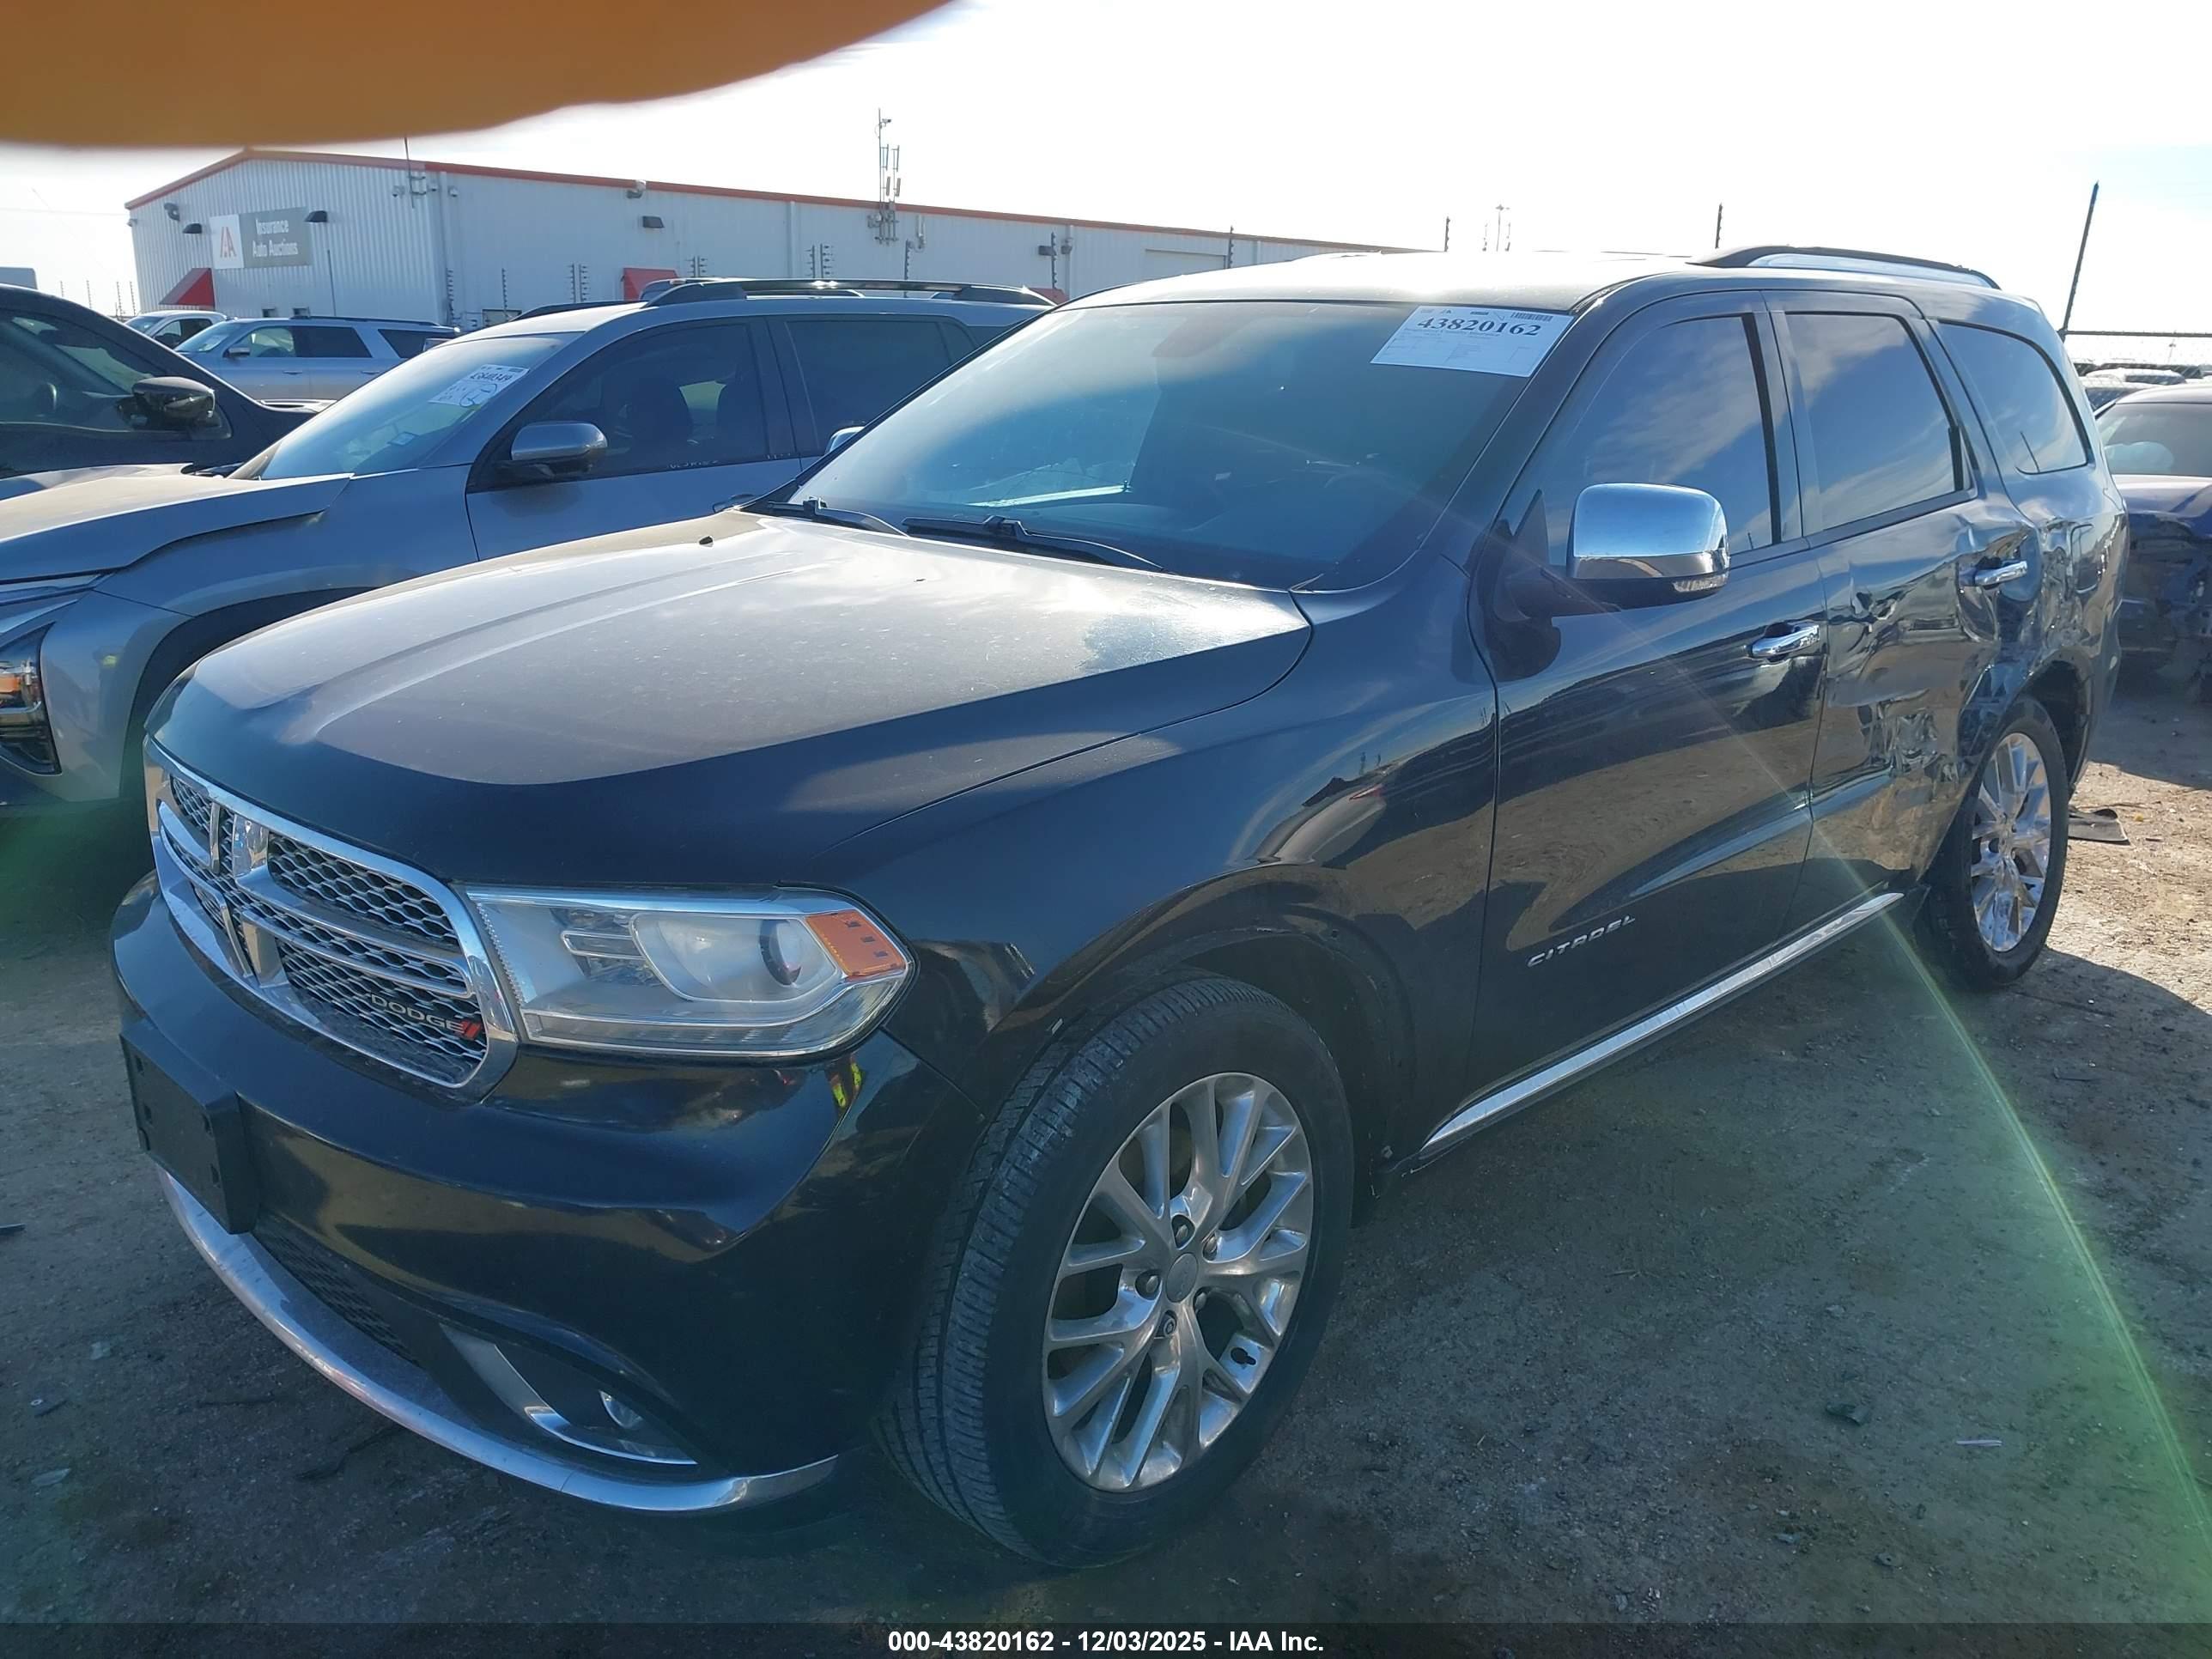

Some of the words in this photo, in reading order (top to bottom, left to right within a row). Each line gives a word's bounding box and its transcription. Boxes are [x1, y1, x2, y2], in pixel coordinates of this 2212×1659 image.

[255, 219, 289, 234] Insurance
[252, 240, 267, 258] Auto
[269, 239, 298, 256] Auctions
[1418, 317, 1541, 336] 43820162
[1527, 915, 1636, 968] CITADEL
[370, 994, 465, 1035] DODGE
